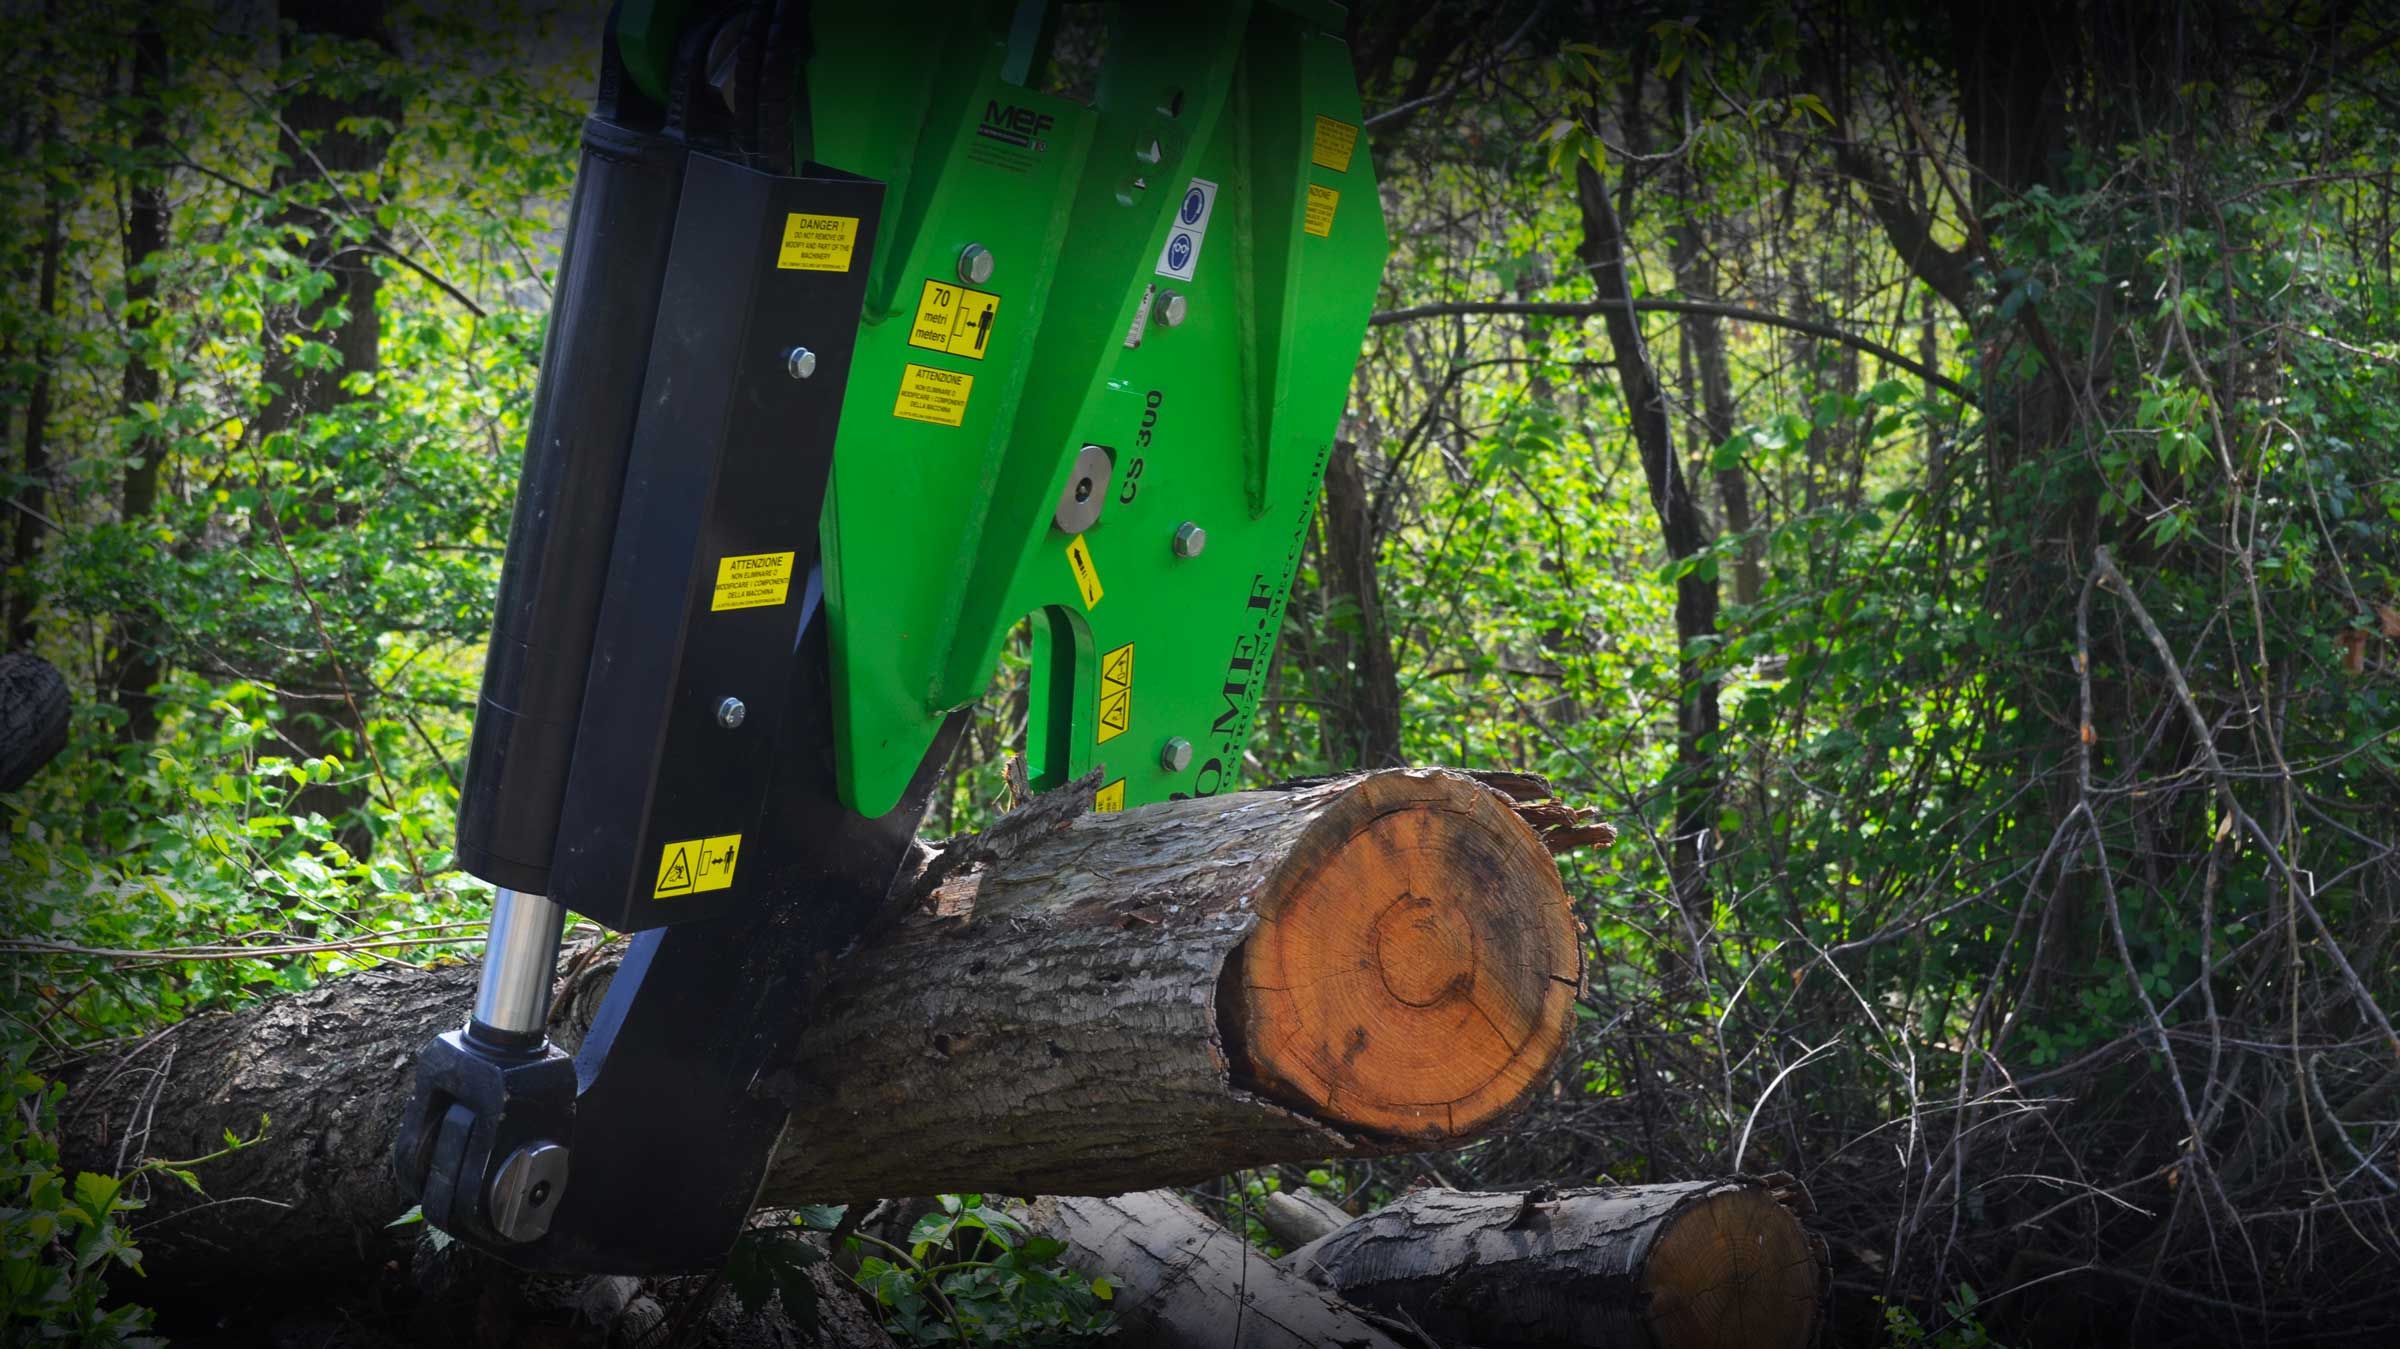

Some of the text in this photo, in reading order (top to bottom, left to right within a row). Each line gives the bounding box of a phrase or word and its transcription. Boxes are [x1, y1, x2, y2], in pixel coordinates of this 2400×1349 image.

[800, 219, 839, 231] DANGER
[800, 252, 831, 260] MACHINERY
[932, 288, 950, 307] 70
[924, 310, 948, 324] metri
[915, 327, 946, 343] meters
[916, 369, 963, 386] ATTENZIONE
[1120, 390, 1162, 504] CS 300
[730, 556, 783, 570] ATTENZIONE
[1169, 574, 1272, 801] O.ME.F
